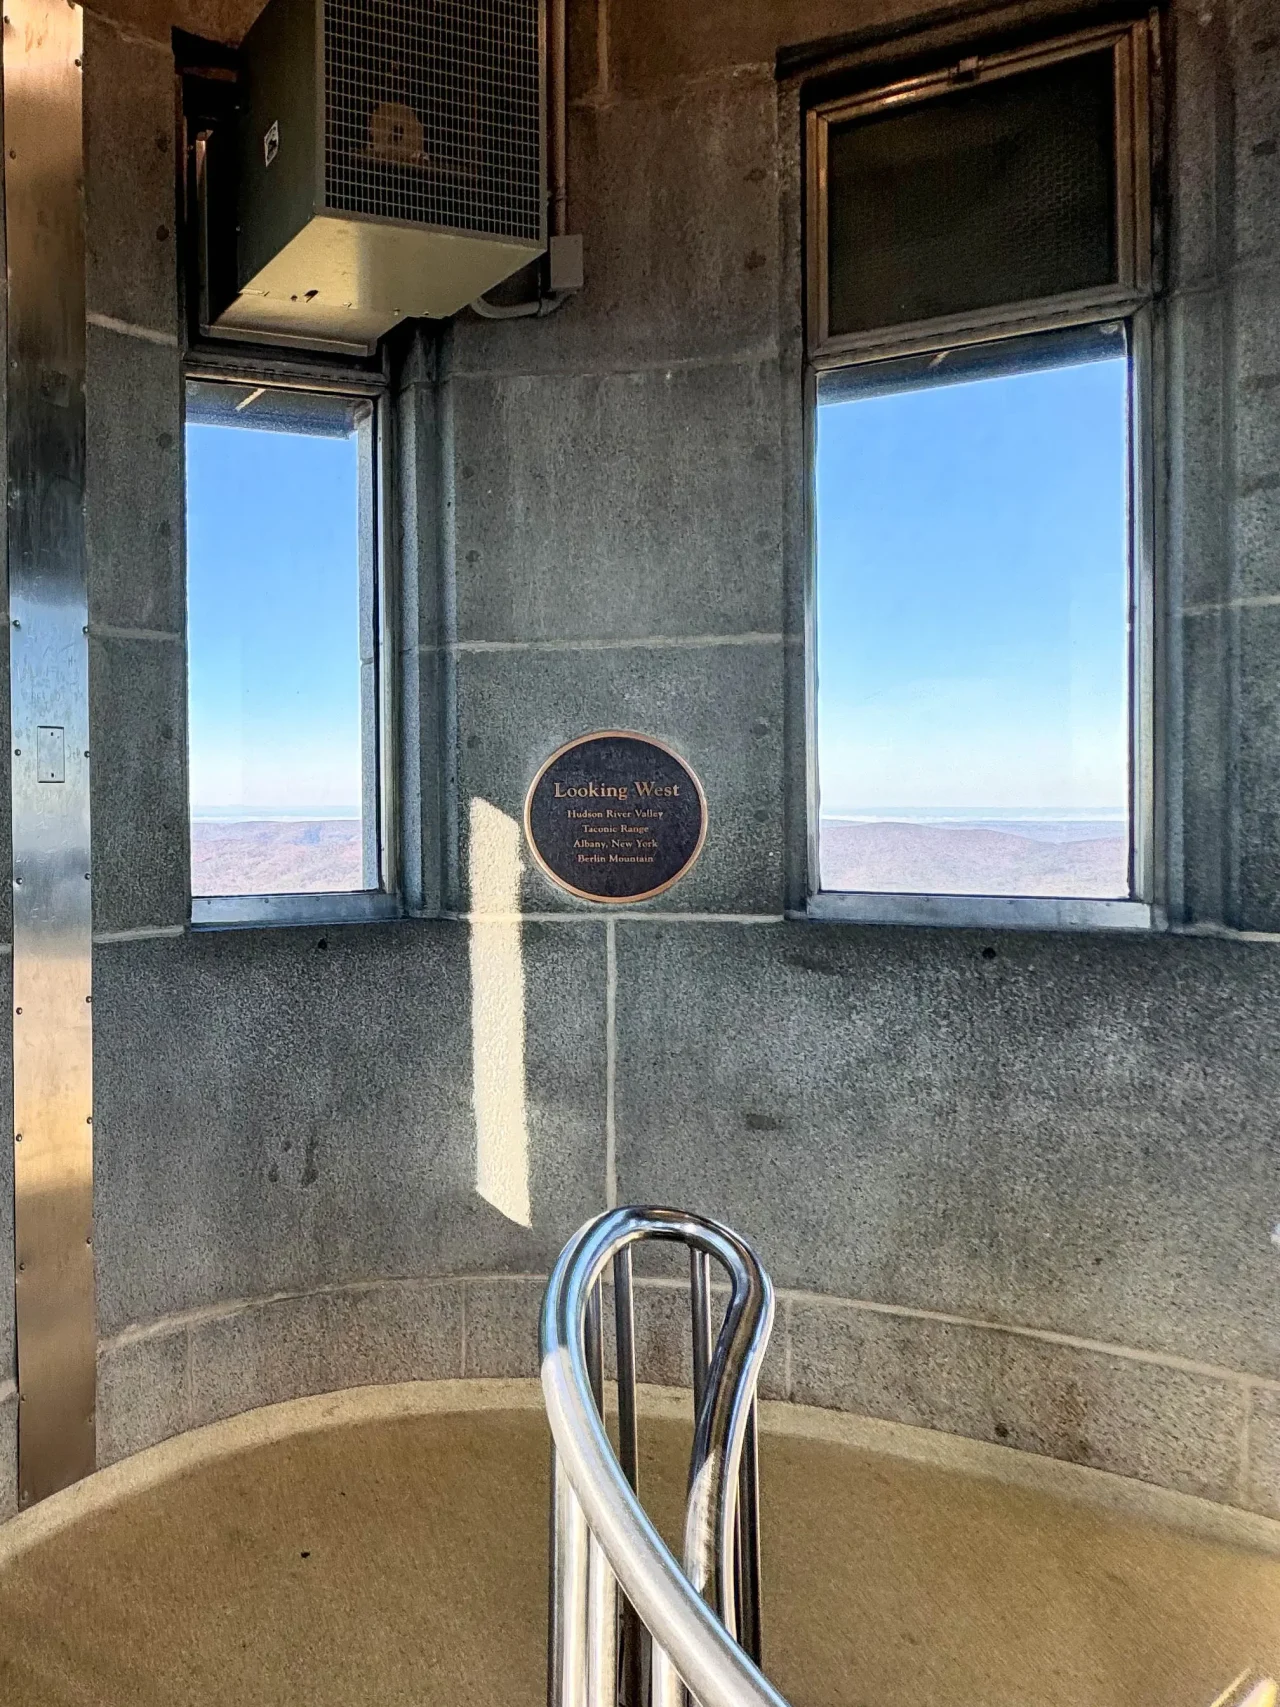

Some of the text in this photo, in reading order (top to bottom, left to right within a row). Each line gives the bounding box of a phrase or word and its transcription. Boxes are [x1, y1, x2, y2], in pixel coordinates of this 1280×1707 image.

[554, 781, 680, 800] Looking West
[567, 809, 663, 819] Hudson River Valley
[582, 825, 649, 834] Taconic Range
[573, 839, 658, 848] Albany, New York
[578, 855, 654, 863] Berlin Mountain
